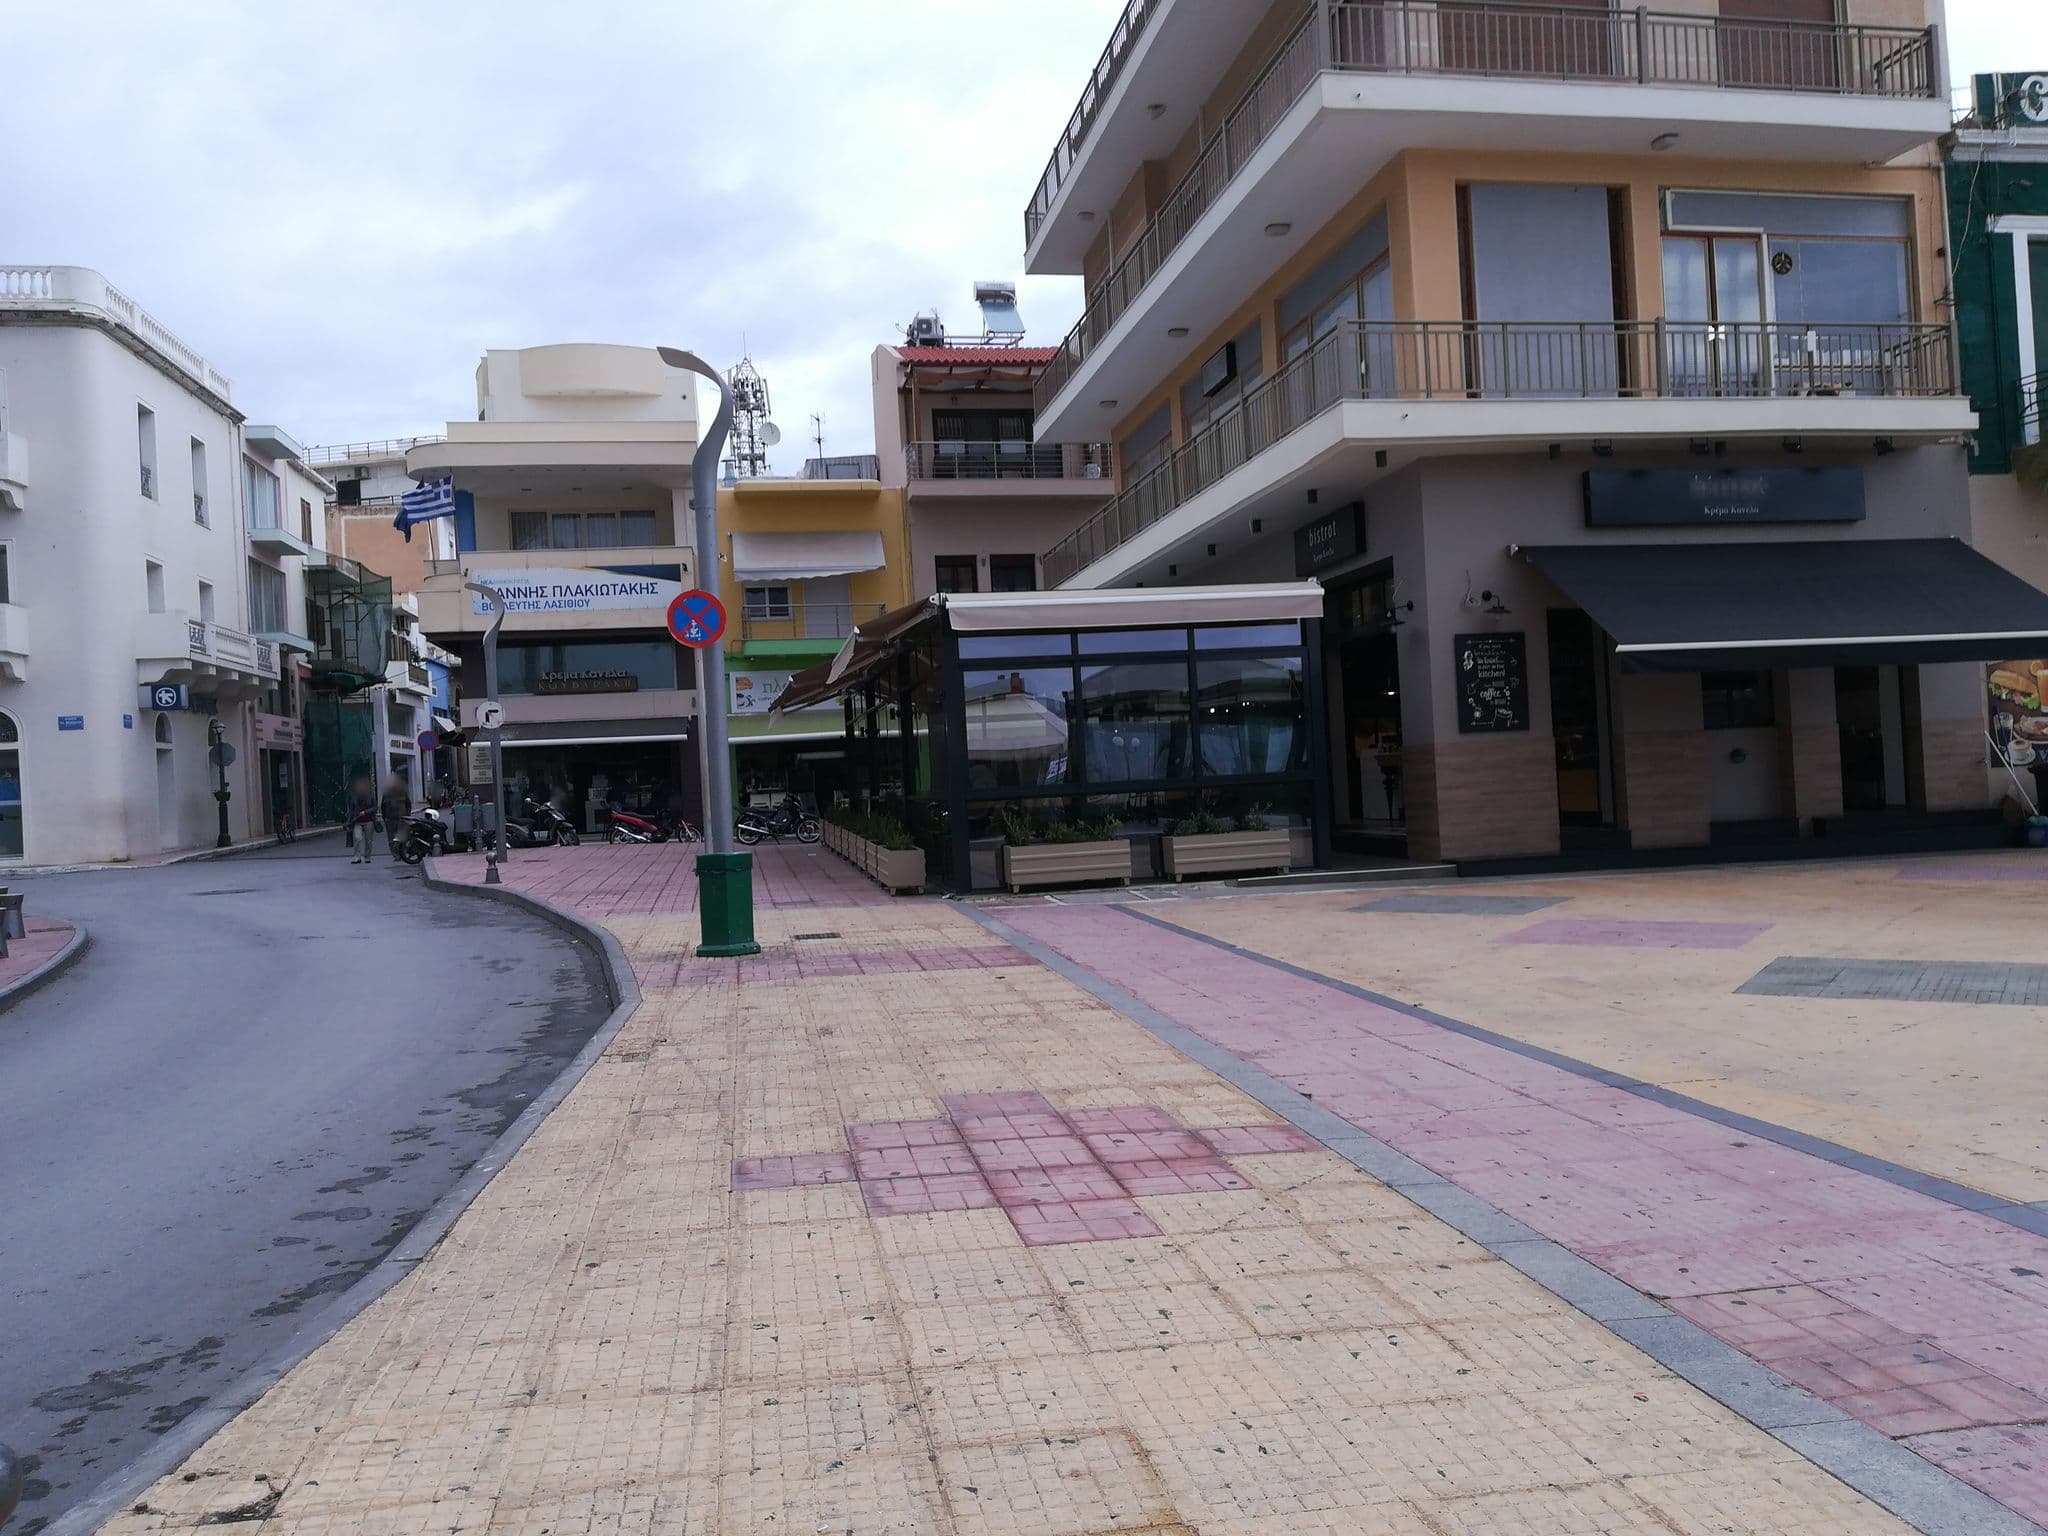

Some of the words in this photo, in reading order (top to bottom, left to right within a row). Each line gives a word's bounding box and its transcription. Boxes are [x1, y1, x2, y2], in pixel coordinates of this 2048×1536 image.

[481, 585, 548, 601] ΑΝΝΗΣ
[552, 582, 659, 598] ΠΛΑΚΙΩΤΑΚΗΣ
[481, 600, 542, 611] ΒΟΛΕΥΤΗΣ
[544, 599, 590, 609] ΛΑΣΙΘΙΟΥ
